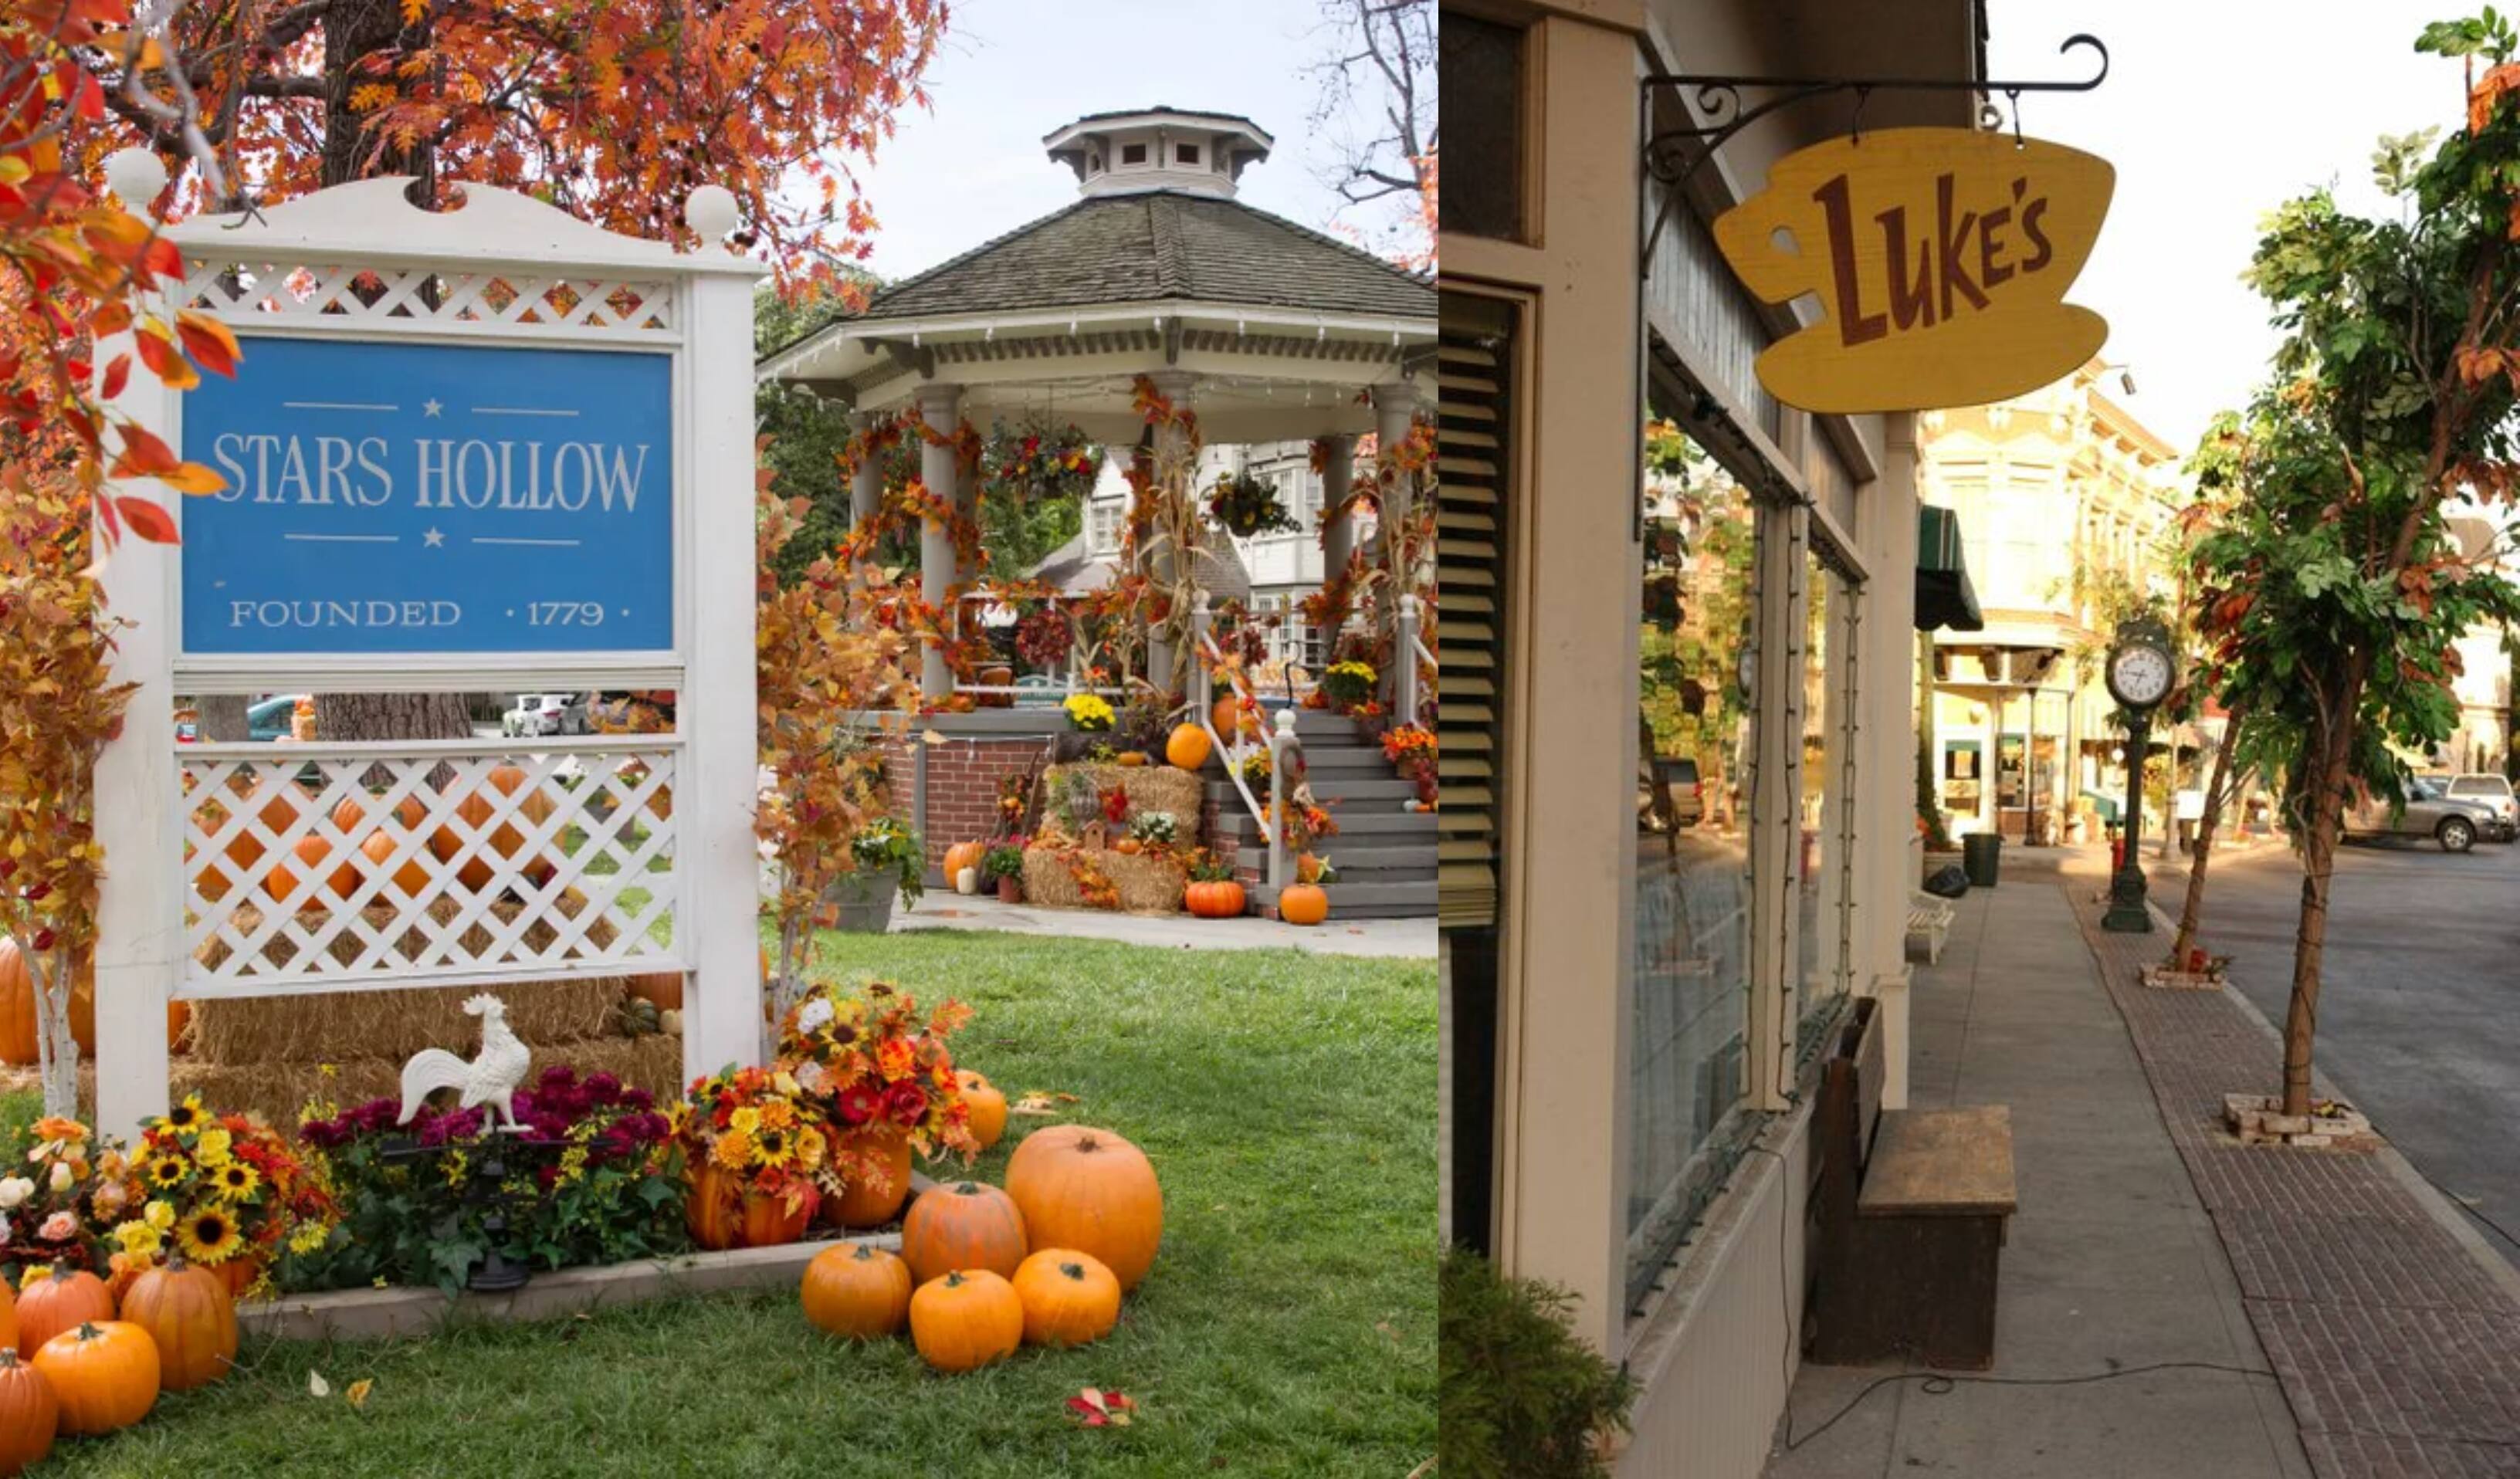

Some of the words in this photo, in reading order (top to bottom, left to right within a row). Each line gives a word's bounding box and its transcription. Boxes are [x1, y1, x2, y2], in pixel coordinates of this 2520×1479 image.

[213, 432, 394, 507] STARS
[414, 438, 650, 513] HOLLOW
[230, 600, 462, 628] FOUNDED
[528, 601, 605, 627] 1779
